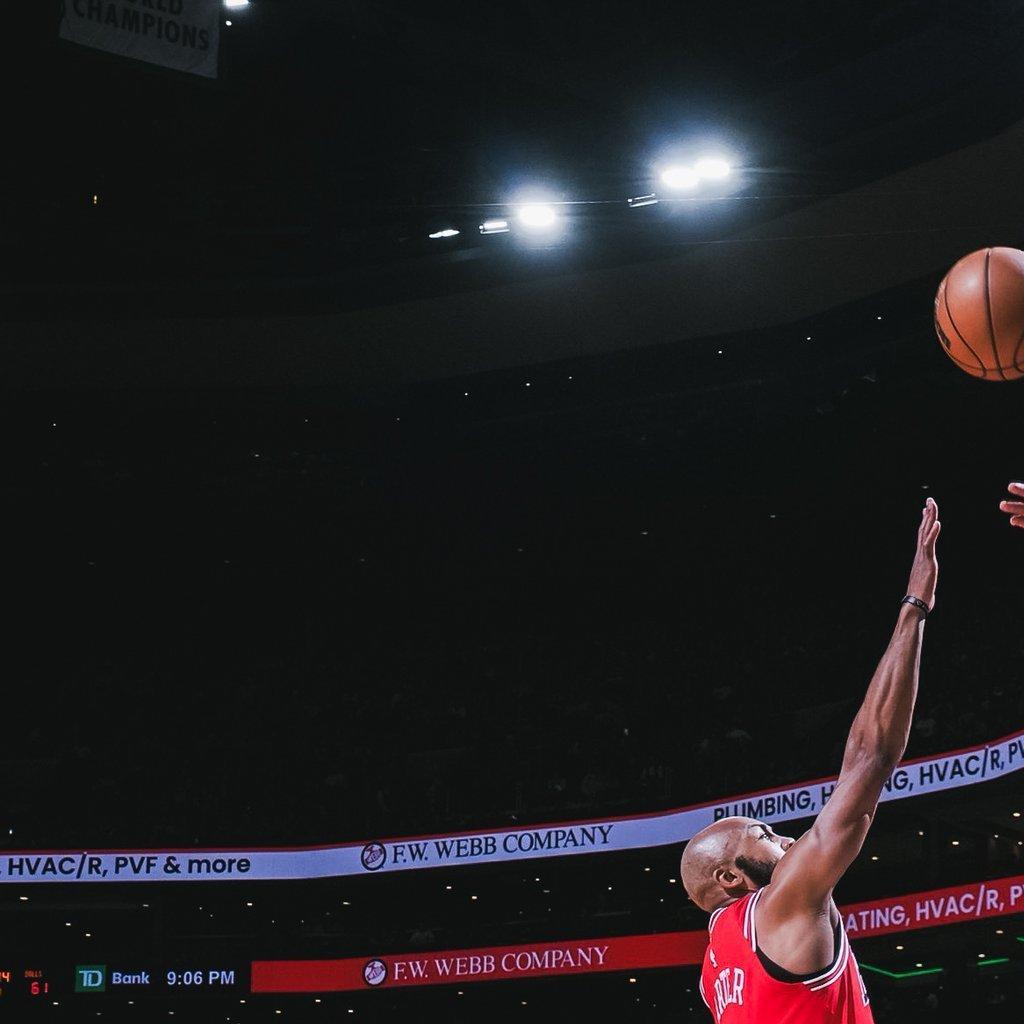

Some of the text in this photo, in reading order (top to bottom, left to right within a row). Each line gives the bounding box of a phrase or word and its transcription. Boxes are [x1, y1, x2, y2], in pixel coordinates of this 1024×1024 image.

[73, 0, 210, 51] CHAMPIONS
[714, 790, 816, 821] PLUMBING,
[920, 745, 1004, 786] HVAC/R,
[393, 824, 614, 864] F.W. WEBB COMPANY
[8, 853, 251, 879] HVAC/R, PVF & more
[842, 904, 909, 934] ATING,
[916, 883, 1004, 920] HVAC/R,
[79, 970, 150, 987] TD Bank
[166, 970, 235, 986] 9:06 PM
[394, 945, 609, 981] F.W. WEBB COMPANY
